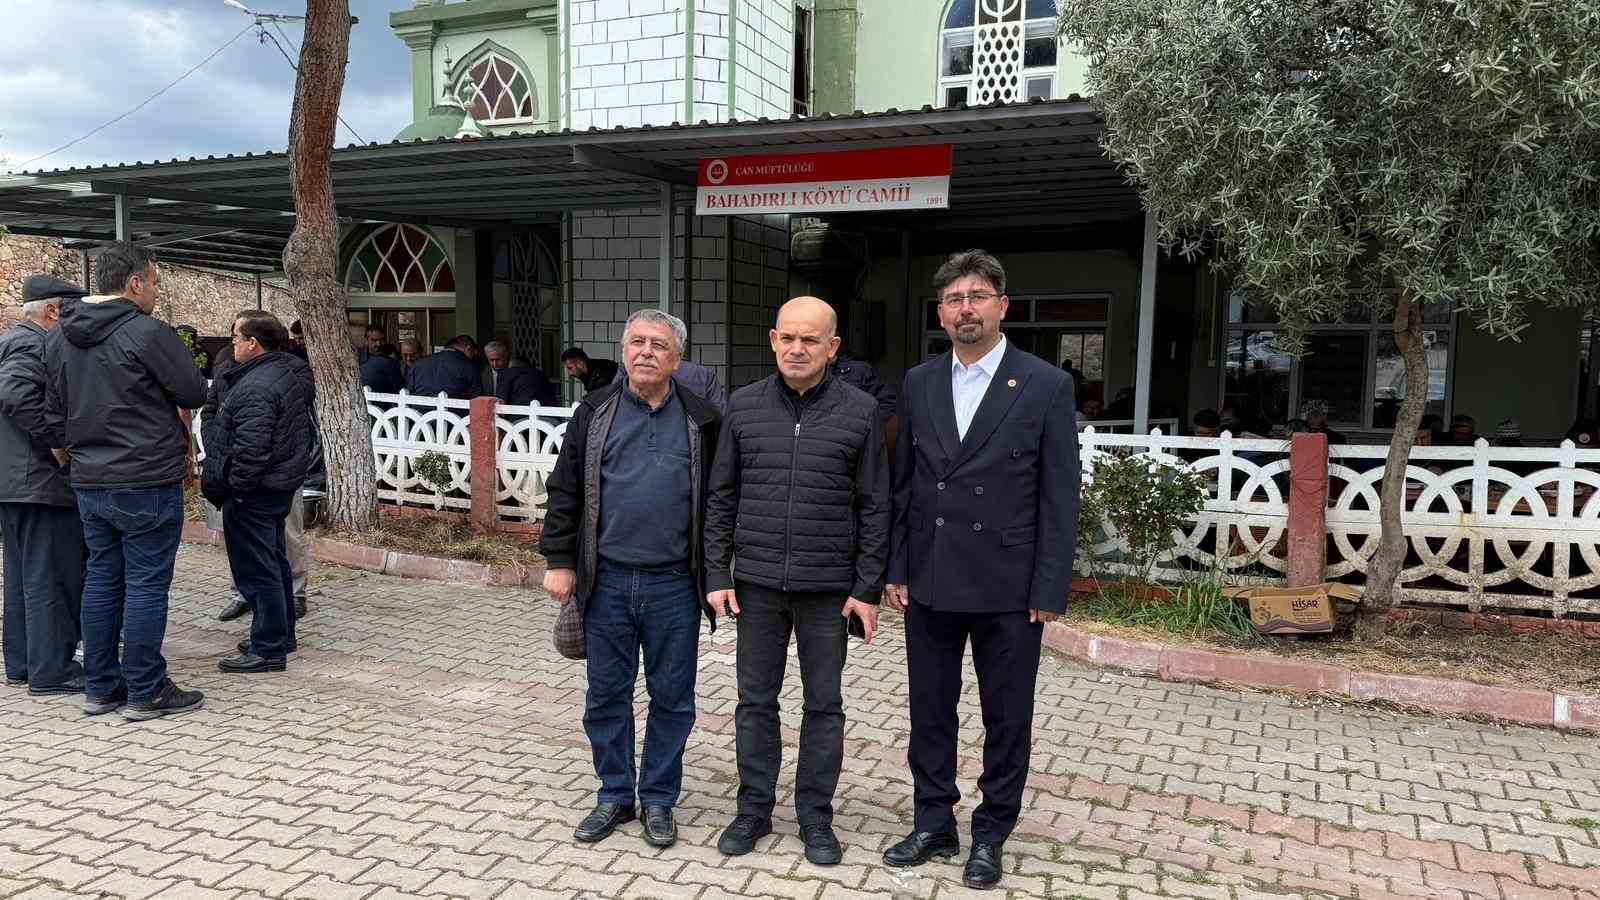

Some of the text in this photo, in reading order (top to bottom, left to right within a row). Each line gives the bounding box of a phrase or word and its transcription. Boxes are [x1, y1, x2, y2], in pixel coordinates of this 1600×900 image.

[735, 162, 815, 177] ÇAN MÜFTÜLÜĞÜ
[707, 183, 911, 208] BAHADIRLI KÖYÜ CAMİİ
[1291, 597, 1319, 609] HİSAR
